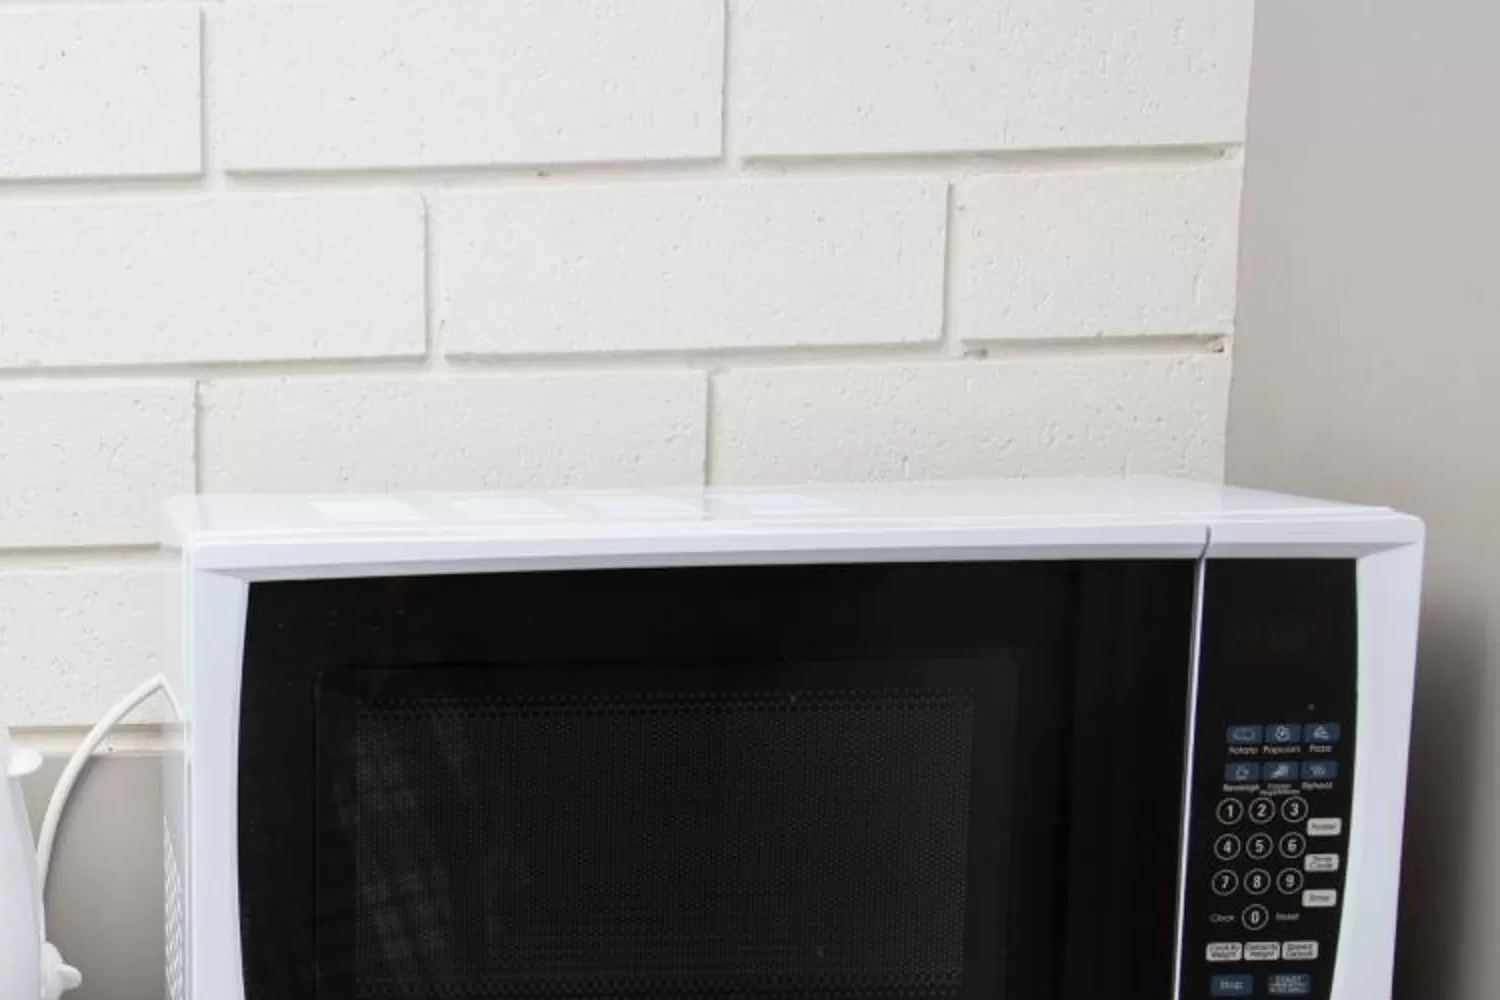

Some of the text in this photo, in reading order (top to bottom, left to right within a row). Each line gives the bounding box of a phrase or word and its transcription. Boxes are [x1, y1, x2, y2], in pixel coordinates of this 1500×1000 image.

[1226, 802, 1300, 818] 1 2 3
[1223, 839, 1297, 853] 4 5 6
[1221, 874, 1295, 889] 7 8 9
[1251, 910, 1259, 924] 0
